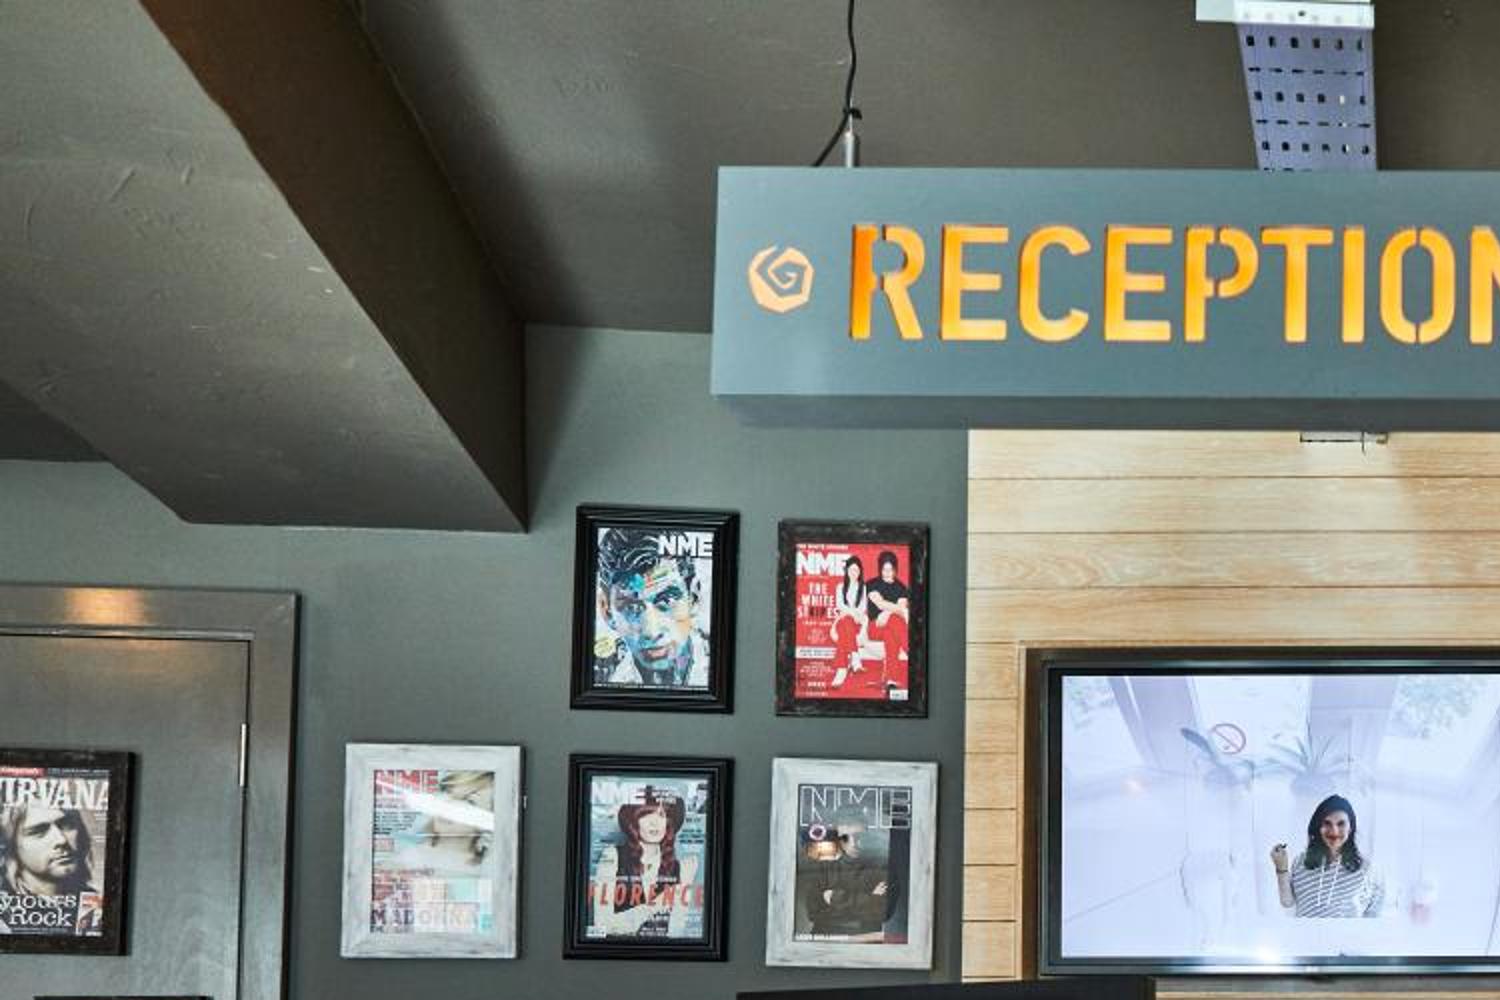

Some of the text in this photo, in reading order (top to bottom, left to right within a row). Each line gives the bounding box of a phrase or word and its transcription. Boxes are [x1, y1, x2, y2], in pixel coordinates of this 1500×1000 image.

[657, 534, 713, 558] NME
[796, 551, 851, 576] NME
[374, 770, 438, 795] NME
[9, 908, 73, 927] Rock
